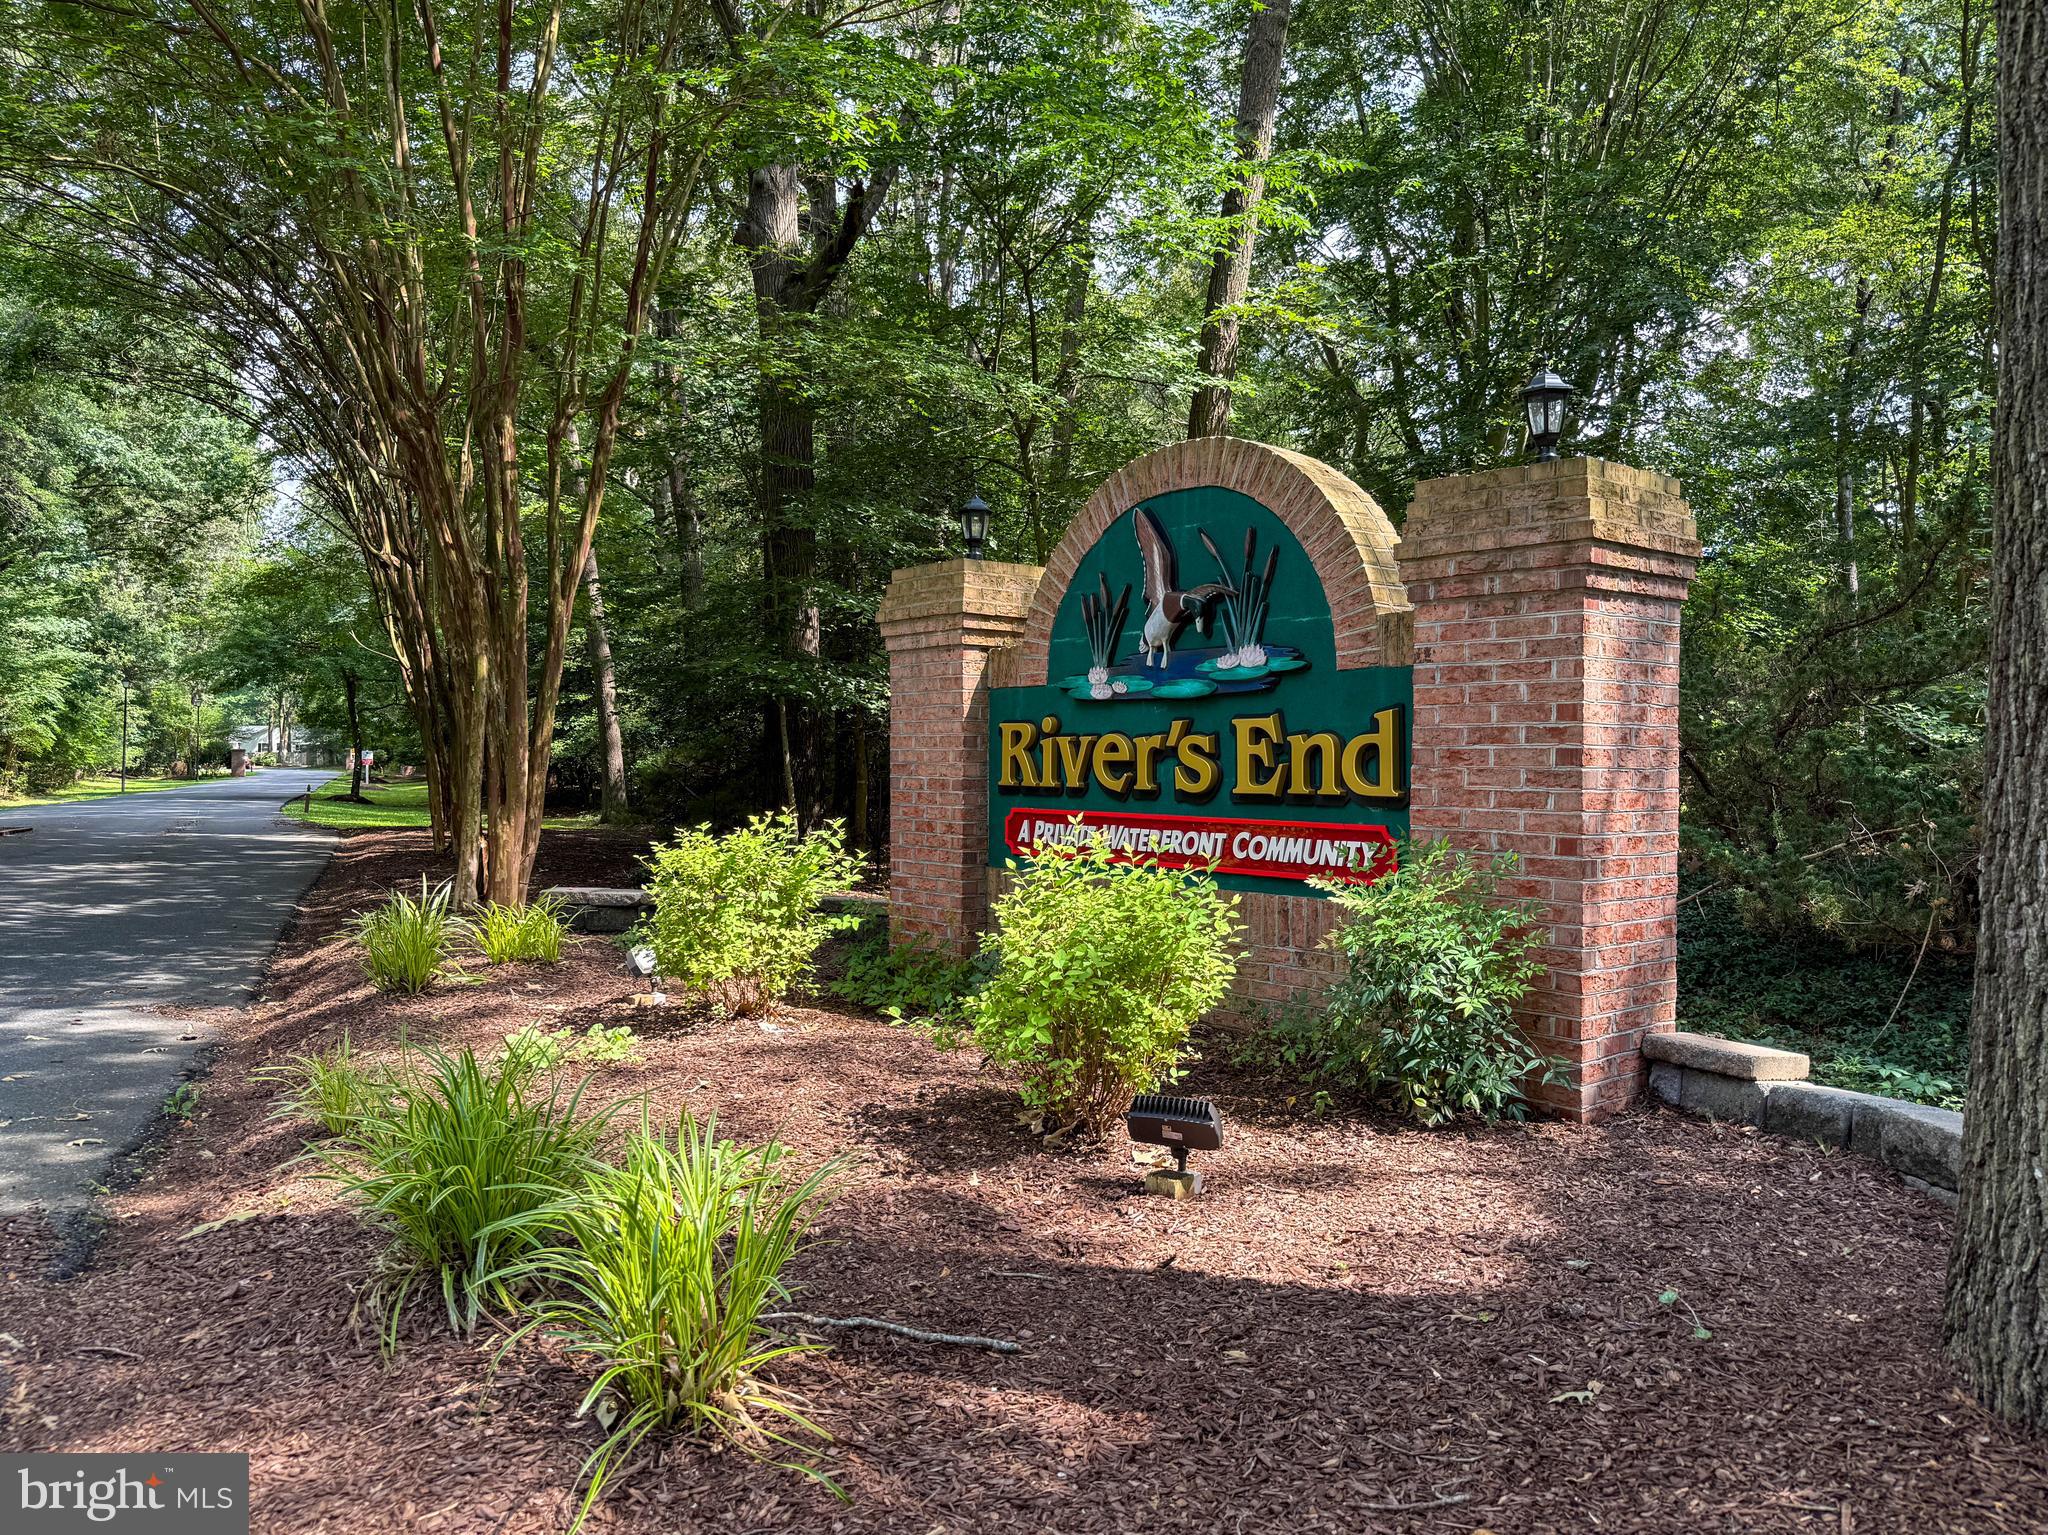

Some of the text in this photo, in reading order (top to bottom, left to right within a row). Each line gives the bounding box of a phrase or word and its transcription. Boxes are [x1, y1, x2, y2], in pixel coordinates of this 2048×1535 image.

[998, 706, 1407, 799] River's End
[1017, 819, 1031, 843] A
[1102, 824, 1227, 858] WATERFRONT
[1232, 831, 1381, 869] COMMUNITY
